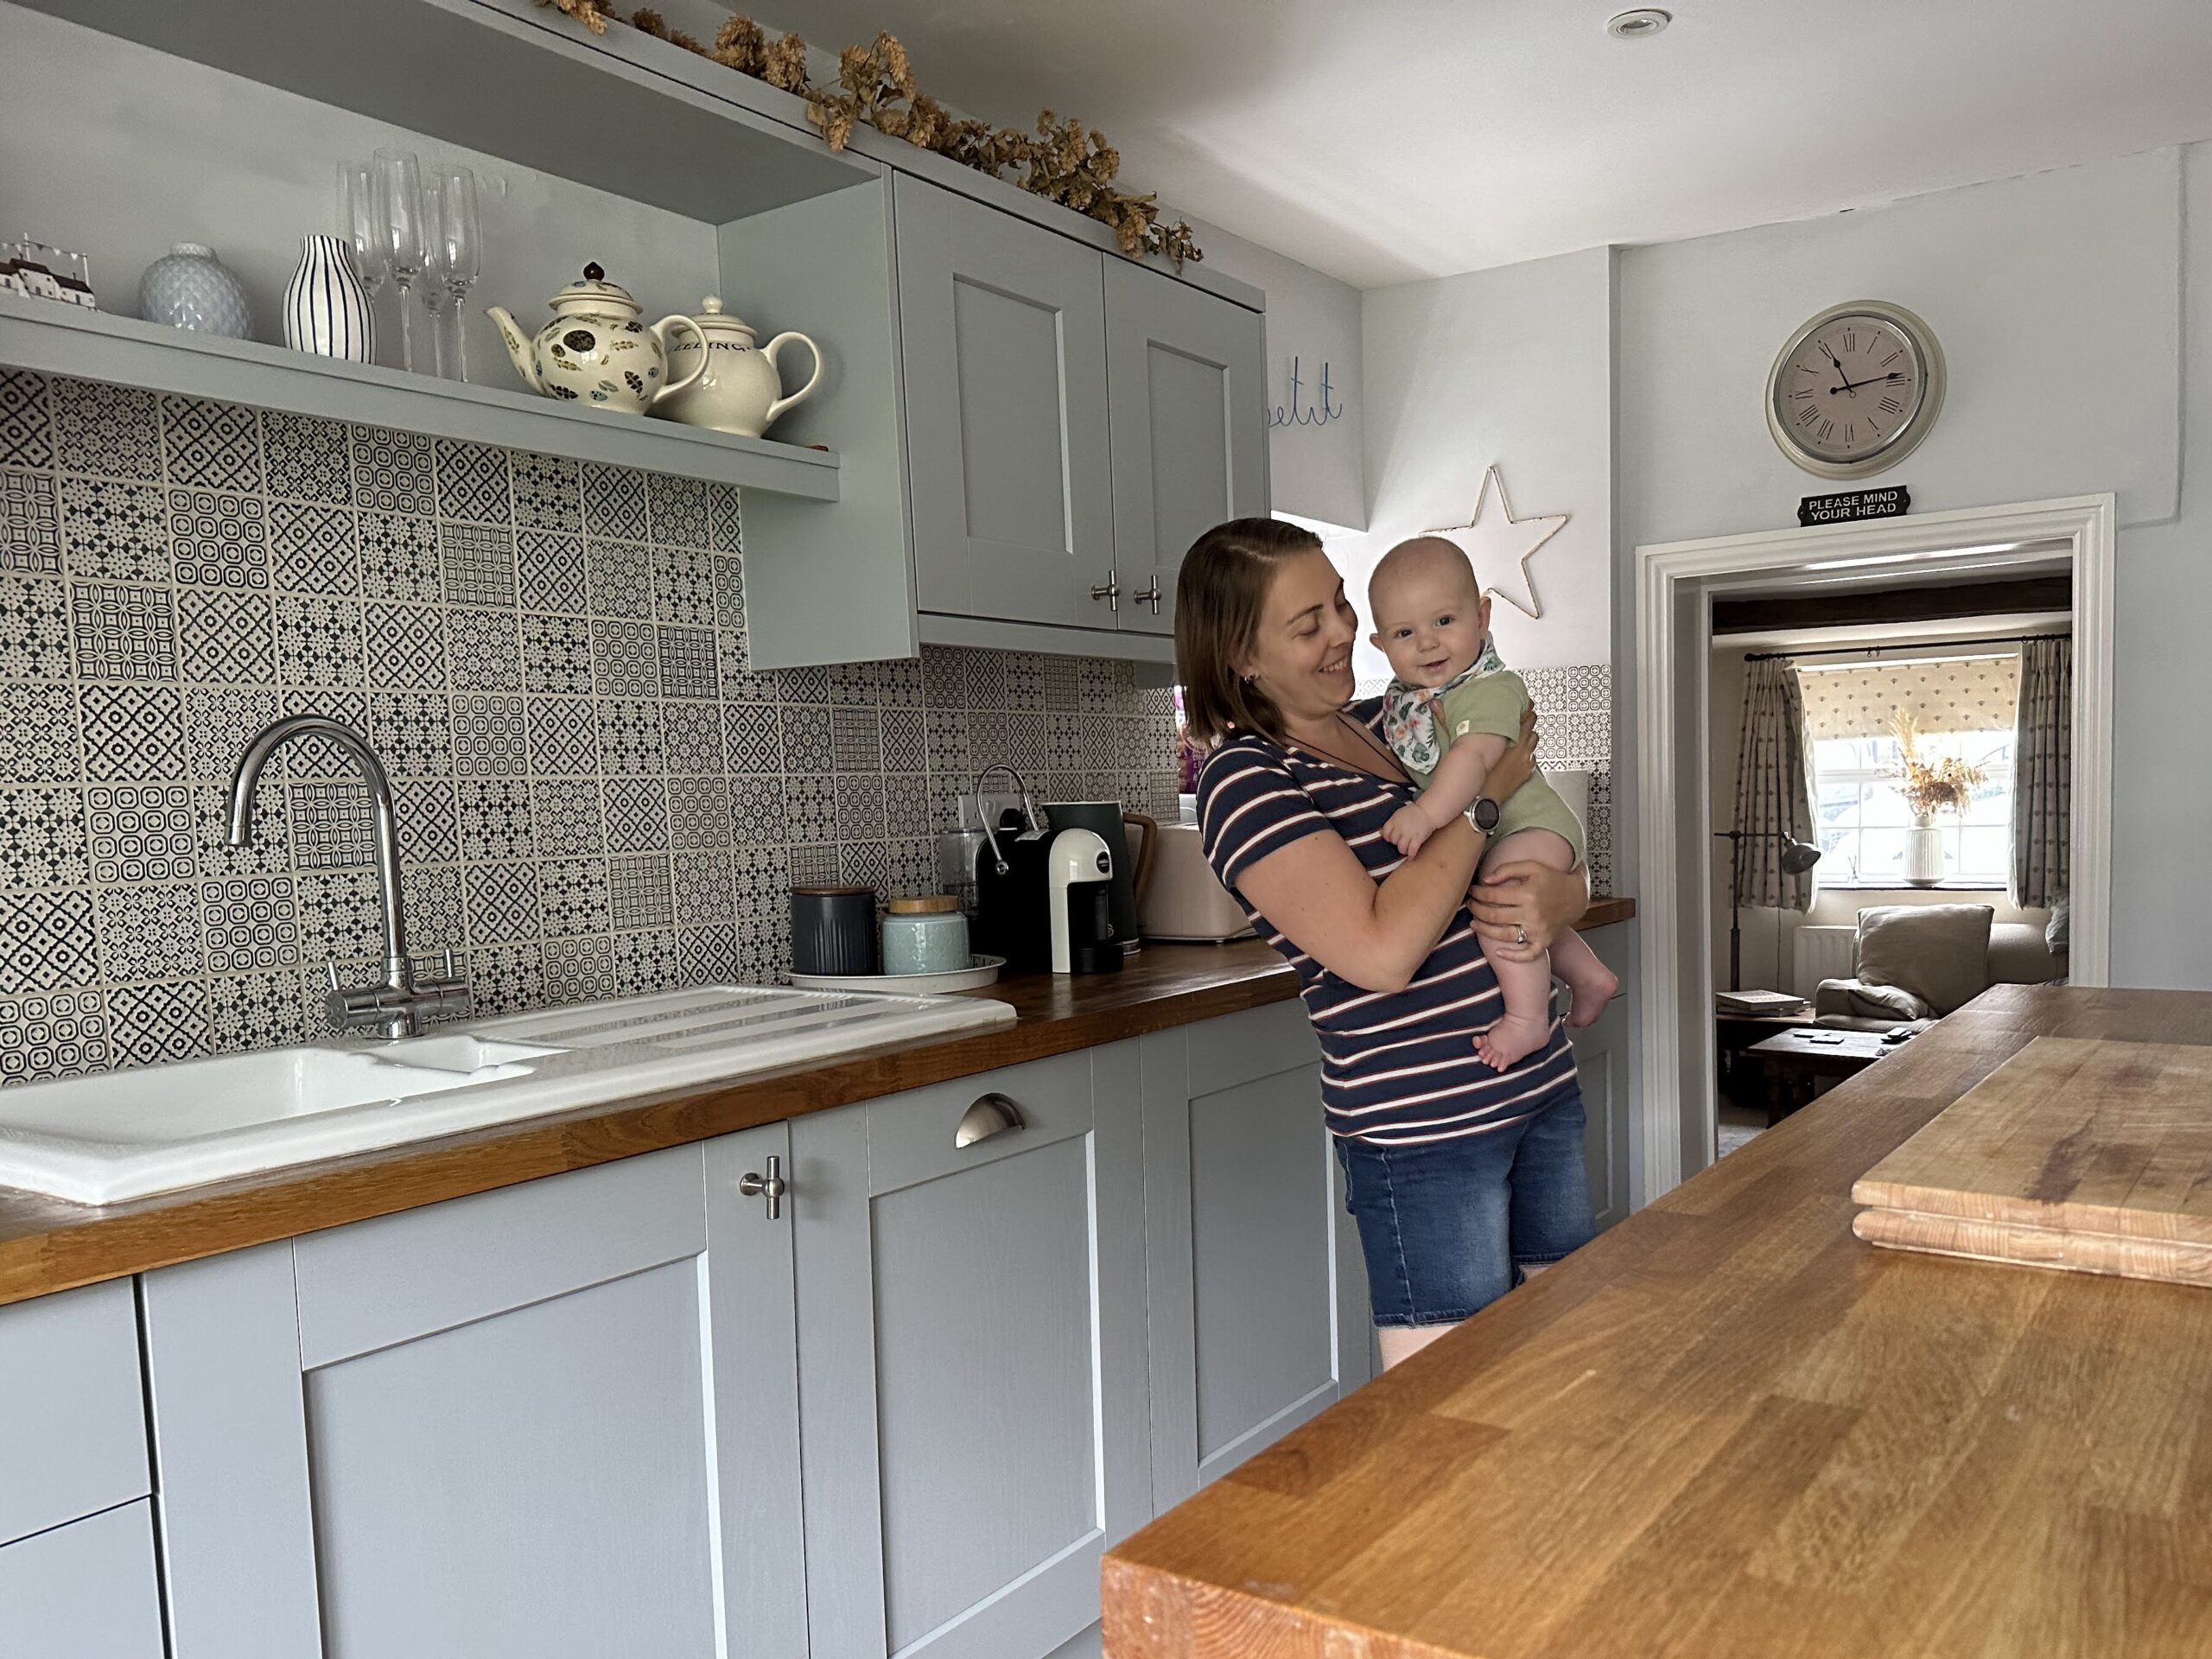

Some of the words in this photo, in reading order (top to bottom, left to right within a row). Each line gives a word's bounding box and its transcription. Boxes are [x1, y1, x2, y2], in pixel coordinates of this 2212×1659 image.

[1808, 495, 1860, 511] PLEASE
[1863, 491, 1898, 505] MIND
[1811, 507, 1851, 521] YOUR
[1856, 503, 1897, 517] HEAD
